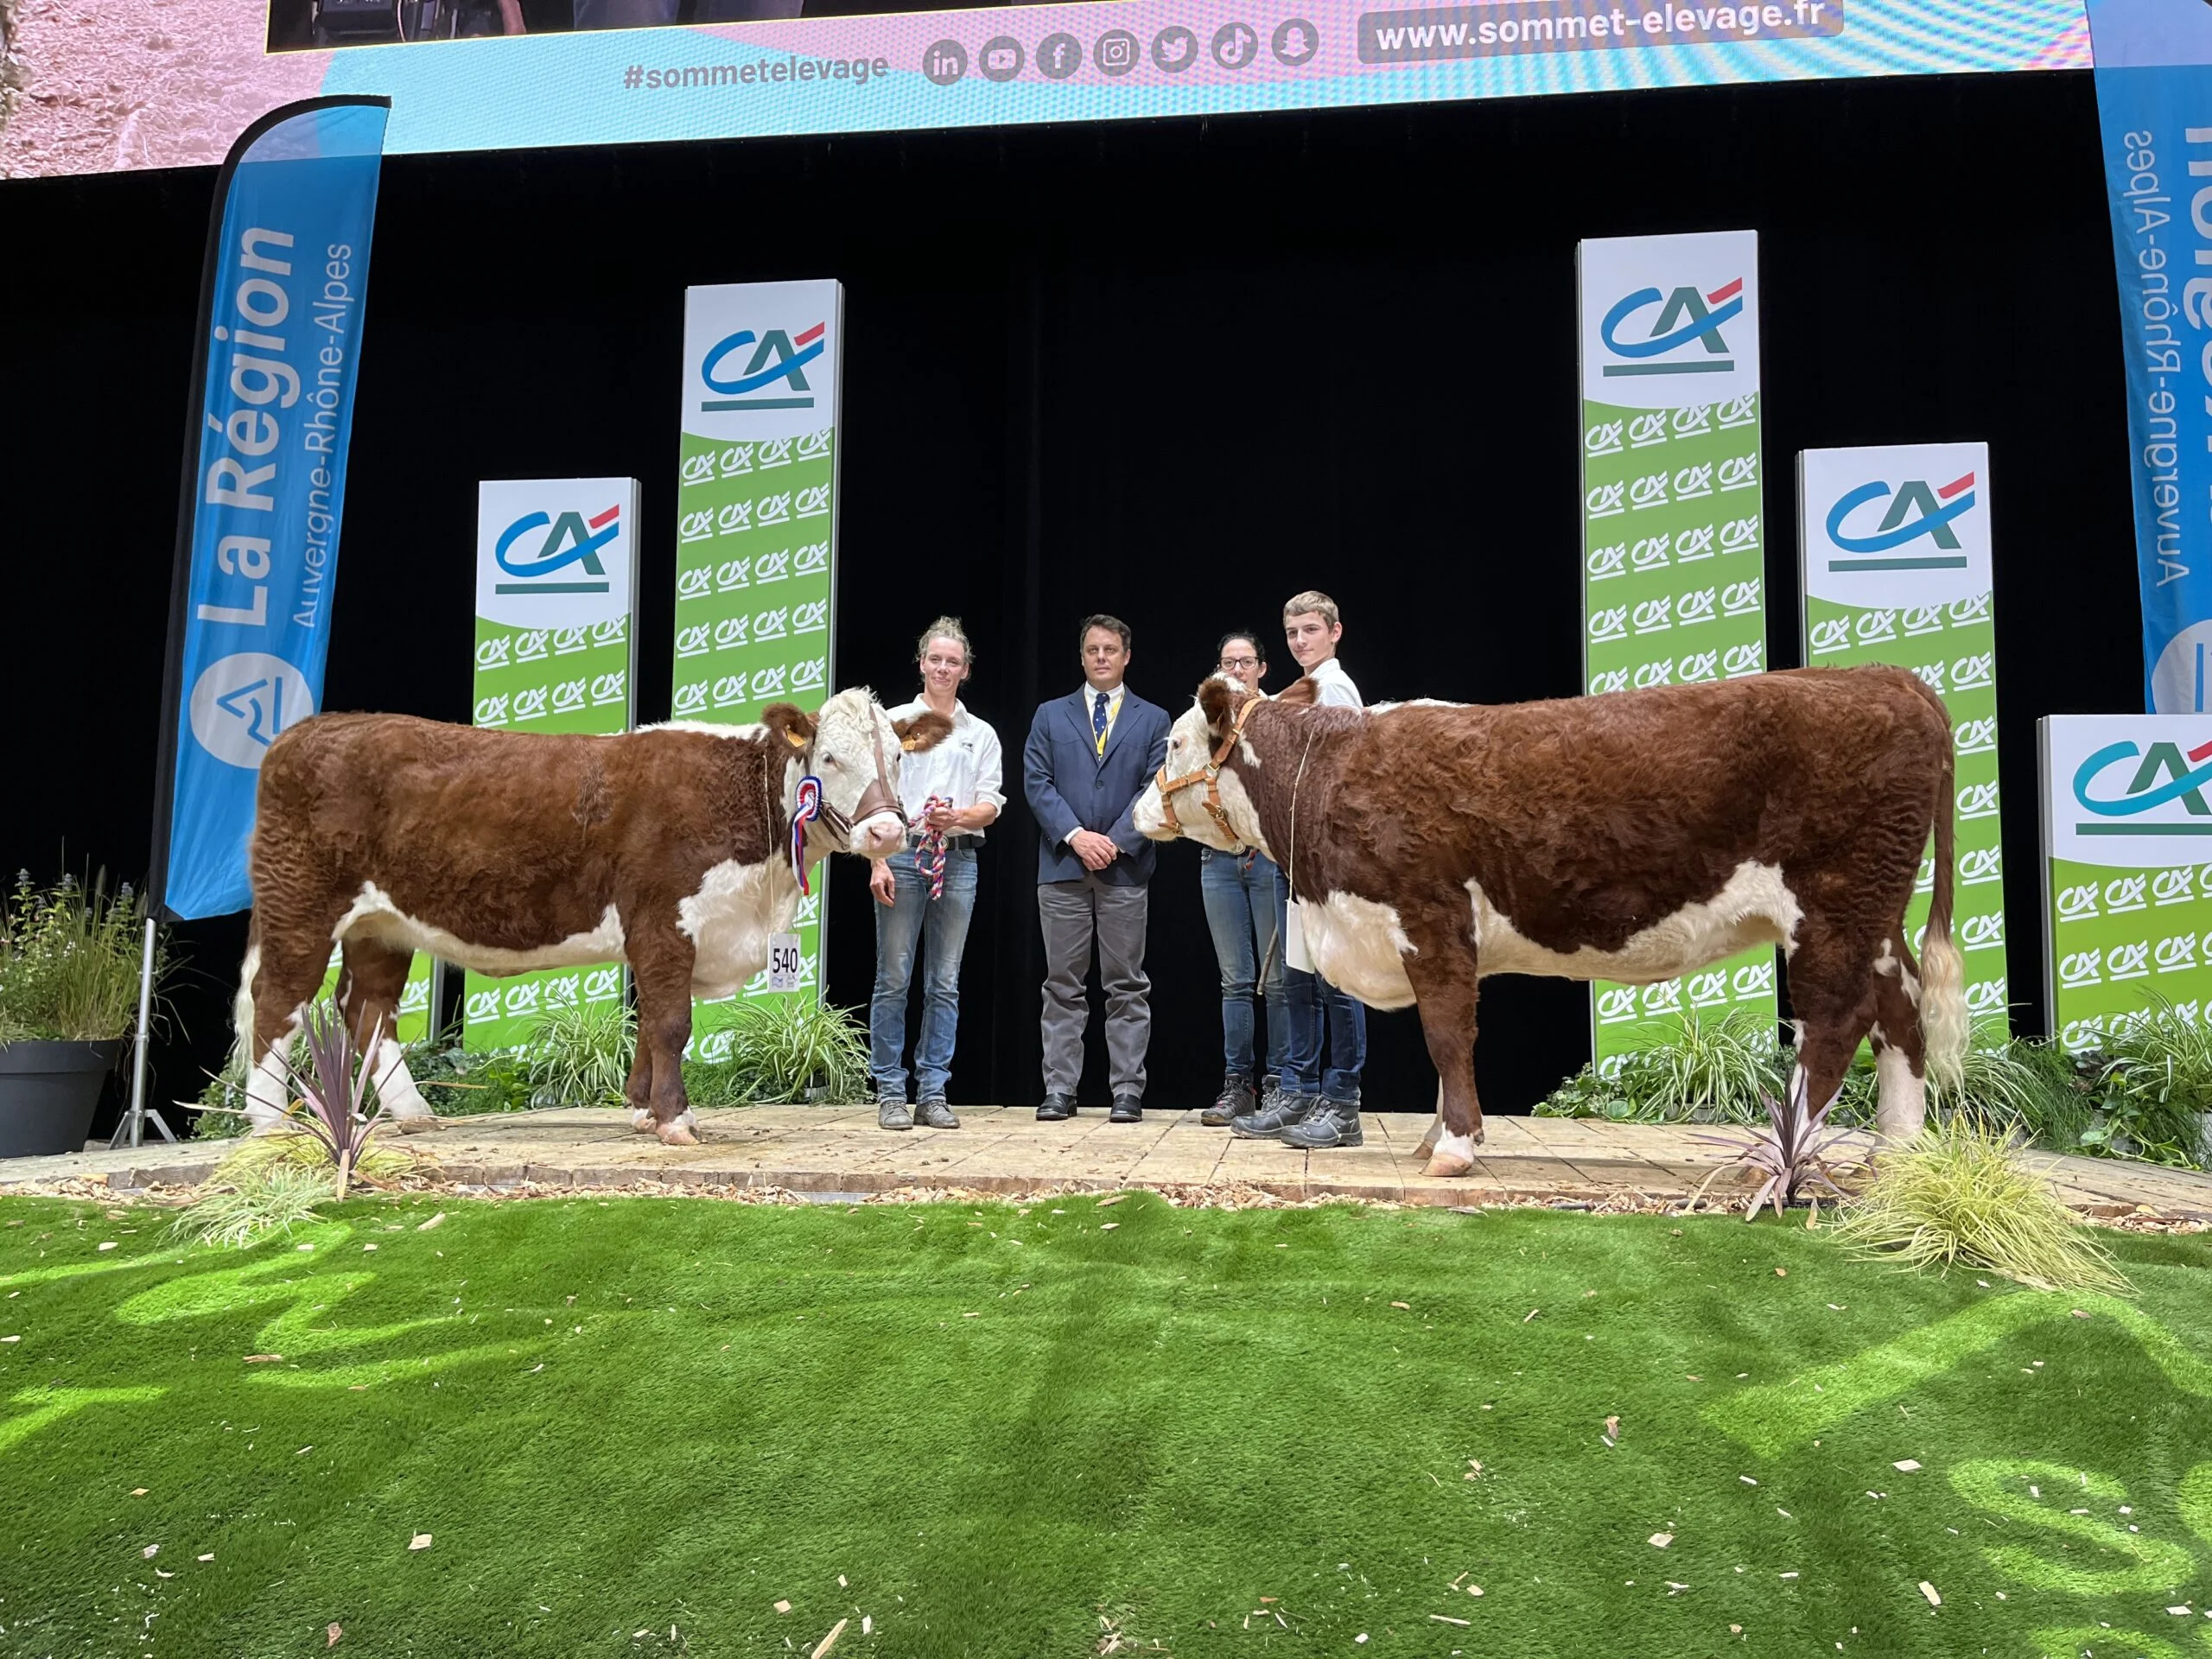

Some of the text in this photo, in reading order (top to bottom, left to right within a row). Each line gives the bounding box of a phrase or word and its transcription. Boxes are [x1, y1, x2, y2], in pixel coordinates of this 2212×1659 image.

[624, 55, 888, 88] #sommetelevage
[1376, 0, 1823, 51] www.sommet-elevage.fr
[702, 321, 826, 395] CA
[1600, 276, 1743, 358] CA
[197, 226, 301, 626] La Région
[293, 244, 354, 628] Auvergne-Rhône-Alpes
[495, 504, 620, 577] CA
[1826, 471, 1976, 553] CA
[773, 948, 798, 974] 540
